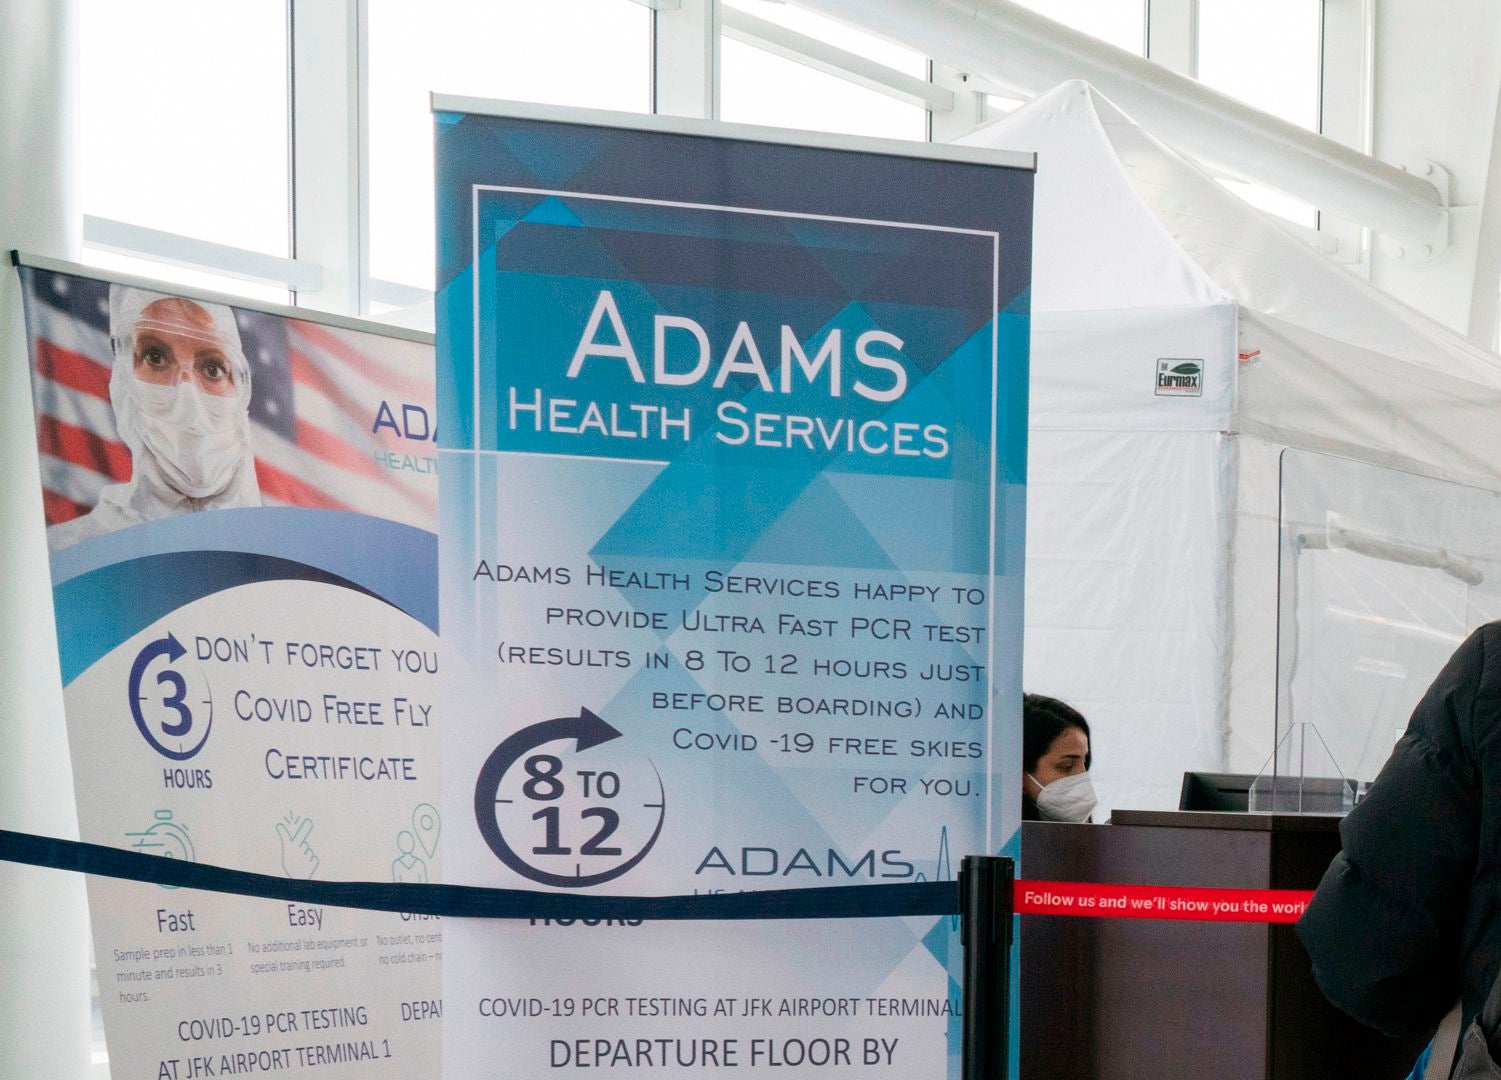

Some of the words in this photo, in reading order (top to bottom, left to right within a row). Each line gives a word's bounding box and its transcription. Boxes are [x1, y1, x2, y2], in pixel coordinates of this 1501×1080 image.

[566, 290, 907, 402] ADAMS
[1159, 373, 1197, 387] Eurmax
[373, 400, 438, 442] AD
[509, 387, 690, 440] HEALTH
[715, 400, 948, 458] SERVICES
[472, 559, 571, 585] ADAMS
[586, 564, 690, 591] HEALTH
[704, 570, 839, 599] SERVICES
[854, 582, 940, 603] HAPPY
[952, 586, 985, 606] TO
[546, 607, 668, 630] PROVIDE
[682, 609, 764, 635] ULTRA
[777, 614, 837, 637] FAST
[850, 617, 911, 641] PCR
[923, 623, 985, 644] TEST
[195, 633, 274, 664] DON'T
[286, 643, 381, 670] FORGET
[497, 641, 630, 668] (RESULTS
[646, 650, 668, 669] IN
[684, 650, 705, 670] 8
[716, 650, 751, 673] TO
[764, 653, 797, 676] 12
[813, 658, 907, 679] HOURS
[919, 662, 985, 682] JUST
[156, 670, 193, 736] 3
[234, 690, 312, 723] COVID
[323, 694, 384, 725] FREE
[394, 698, 432, 727] FLY
[652, 691, 763, 712] BEFORE
[777, 695, 922, 720] BOARDING)
[933, 701, 984, 722] AND
[673, 727, 757, 752] COVID
[770, 732, 814, 754] -19
[829, 736, 897, 756] FREE
[910, 738, 983, 759] SKIES
[164, 768, 213, 789] HOURS
[265, 748, 417, 780] CERTIFICATE
[522, 755, 564, 801] 8
[577, 770, 621, 799] TO
[853, 776, 906, 795] FOR
[920, 778, 980, 798] YOU.
[532, 805, 622, 857] 12
[695, 847, 914, 878] ADAMS
[157, 909, 195, 932] Fast
[288, 904, 323, 931] Easy
[1025, 891, 1073, 906] Follow
[1078, 895, 1095, 907] us
[1099, 896, 1126, 909] and
[1132, 896, 1165, 911] we'll
[1170, 898, 1208, 912] show
[1213, 902, 1239, 915] you
[1244, 900, 1267, 913] the
[114, 948, 150, 962] Sample
[154, 948, 175, 961] prep
[178, 945, 187, 957] in
[189, 944, 205, 957] less
[206, 944, 225, 956] than
[117, 970, 152, 983] minute
[155, 967, 173, 979] and
[176, 965, 205, 978] results
[207, 965, 215, 976] in
[178, 1015, 261, 1041] COVID-19
[267, 1012, 298, 1034] PCR
[301, 1006, 368, 1031] TESTING
[479, 997, 574, 1018] COVID-19
[582, 998, 620, 1018] PCR
[625, 997, 707, 1018] TESTING
[713, 998, 737, 1018] AT
[741, 998, 773, 1019] JFK
[778, 998, 860, 1018] AIRPORT
[866, 998, 963, 1018] TERMINAL
[186, 1055, 215, 1079] JFK
[220, 1048, 292, 1076] AIRPORT
[295, 1040, 379, 1067] TERMINAL
[383, 1039, 392, 1058] 1
[550, 1038, 739, 1069] DEPARTURE
[751, 1038, 850, 1068] FLOOR
[862, 1037, 899, 1067] BY
